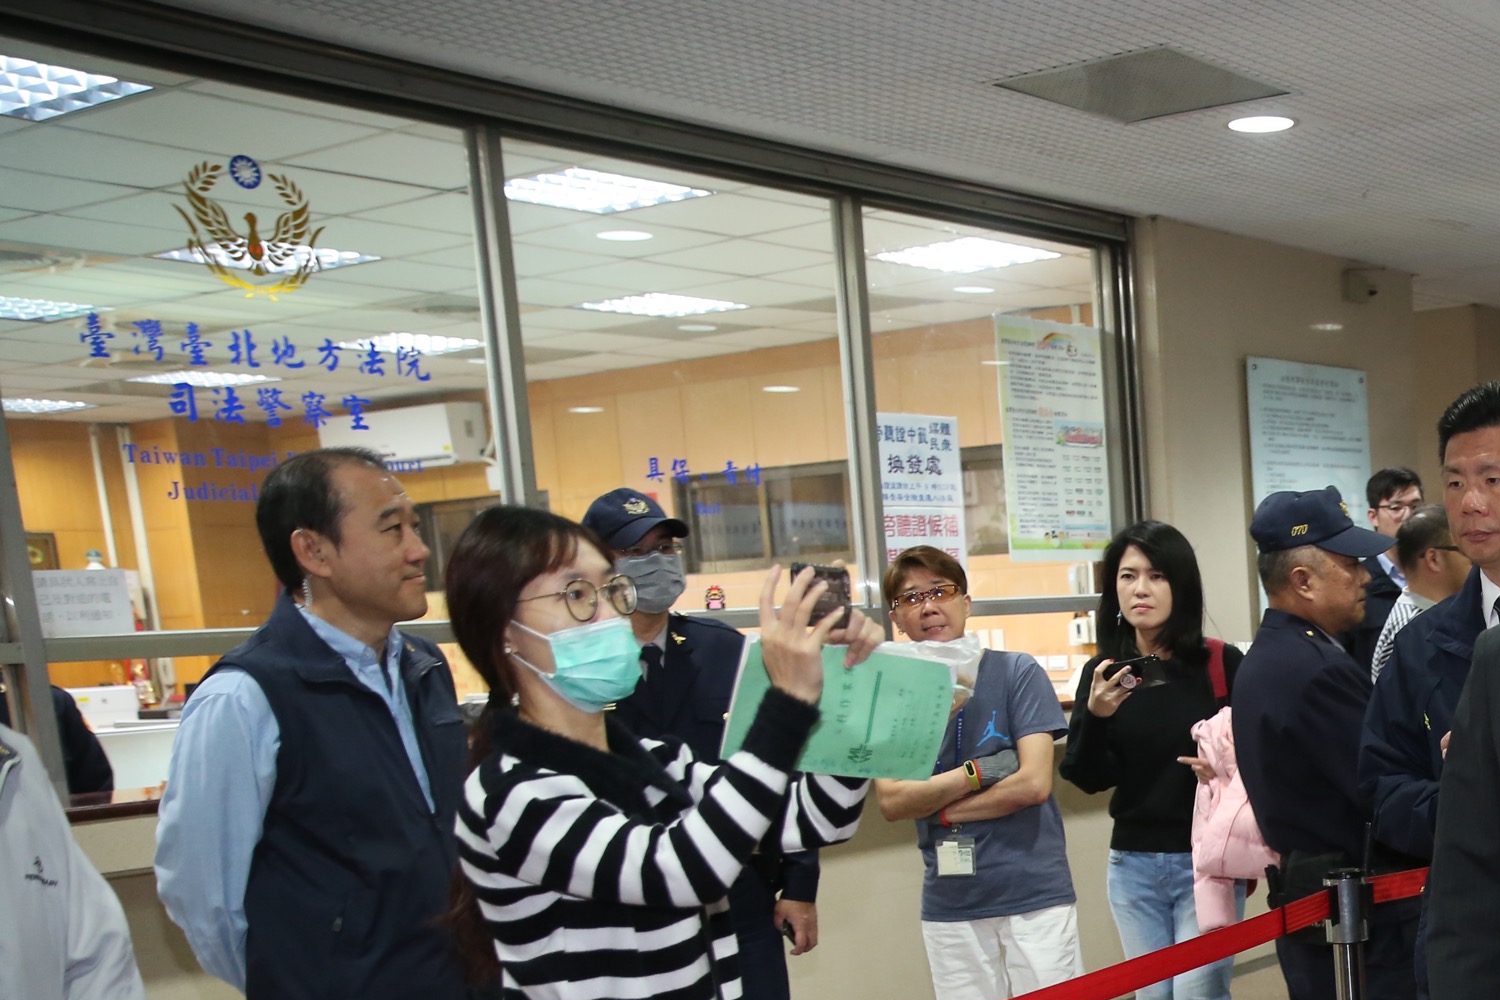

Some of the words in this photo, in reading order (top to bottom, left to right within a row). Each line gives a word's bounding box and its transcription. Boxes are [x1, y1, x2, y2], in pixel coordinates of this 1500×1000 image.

[79, 312, 431, 381] 臺灣臺北地方法院
[168, 382, 371, 430] 司法警察室
[123, 444, 206, 467] Taiwan
[210, 448, 279, 472] Taipei
[384, 457, 424, 473] ourt
[887, 454, 942, 475] 換發處
[167, 481, 258, 502] Judicial
[1291, 523, 1309, 537] 070
